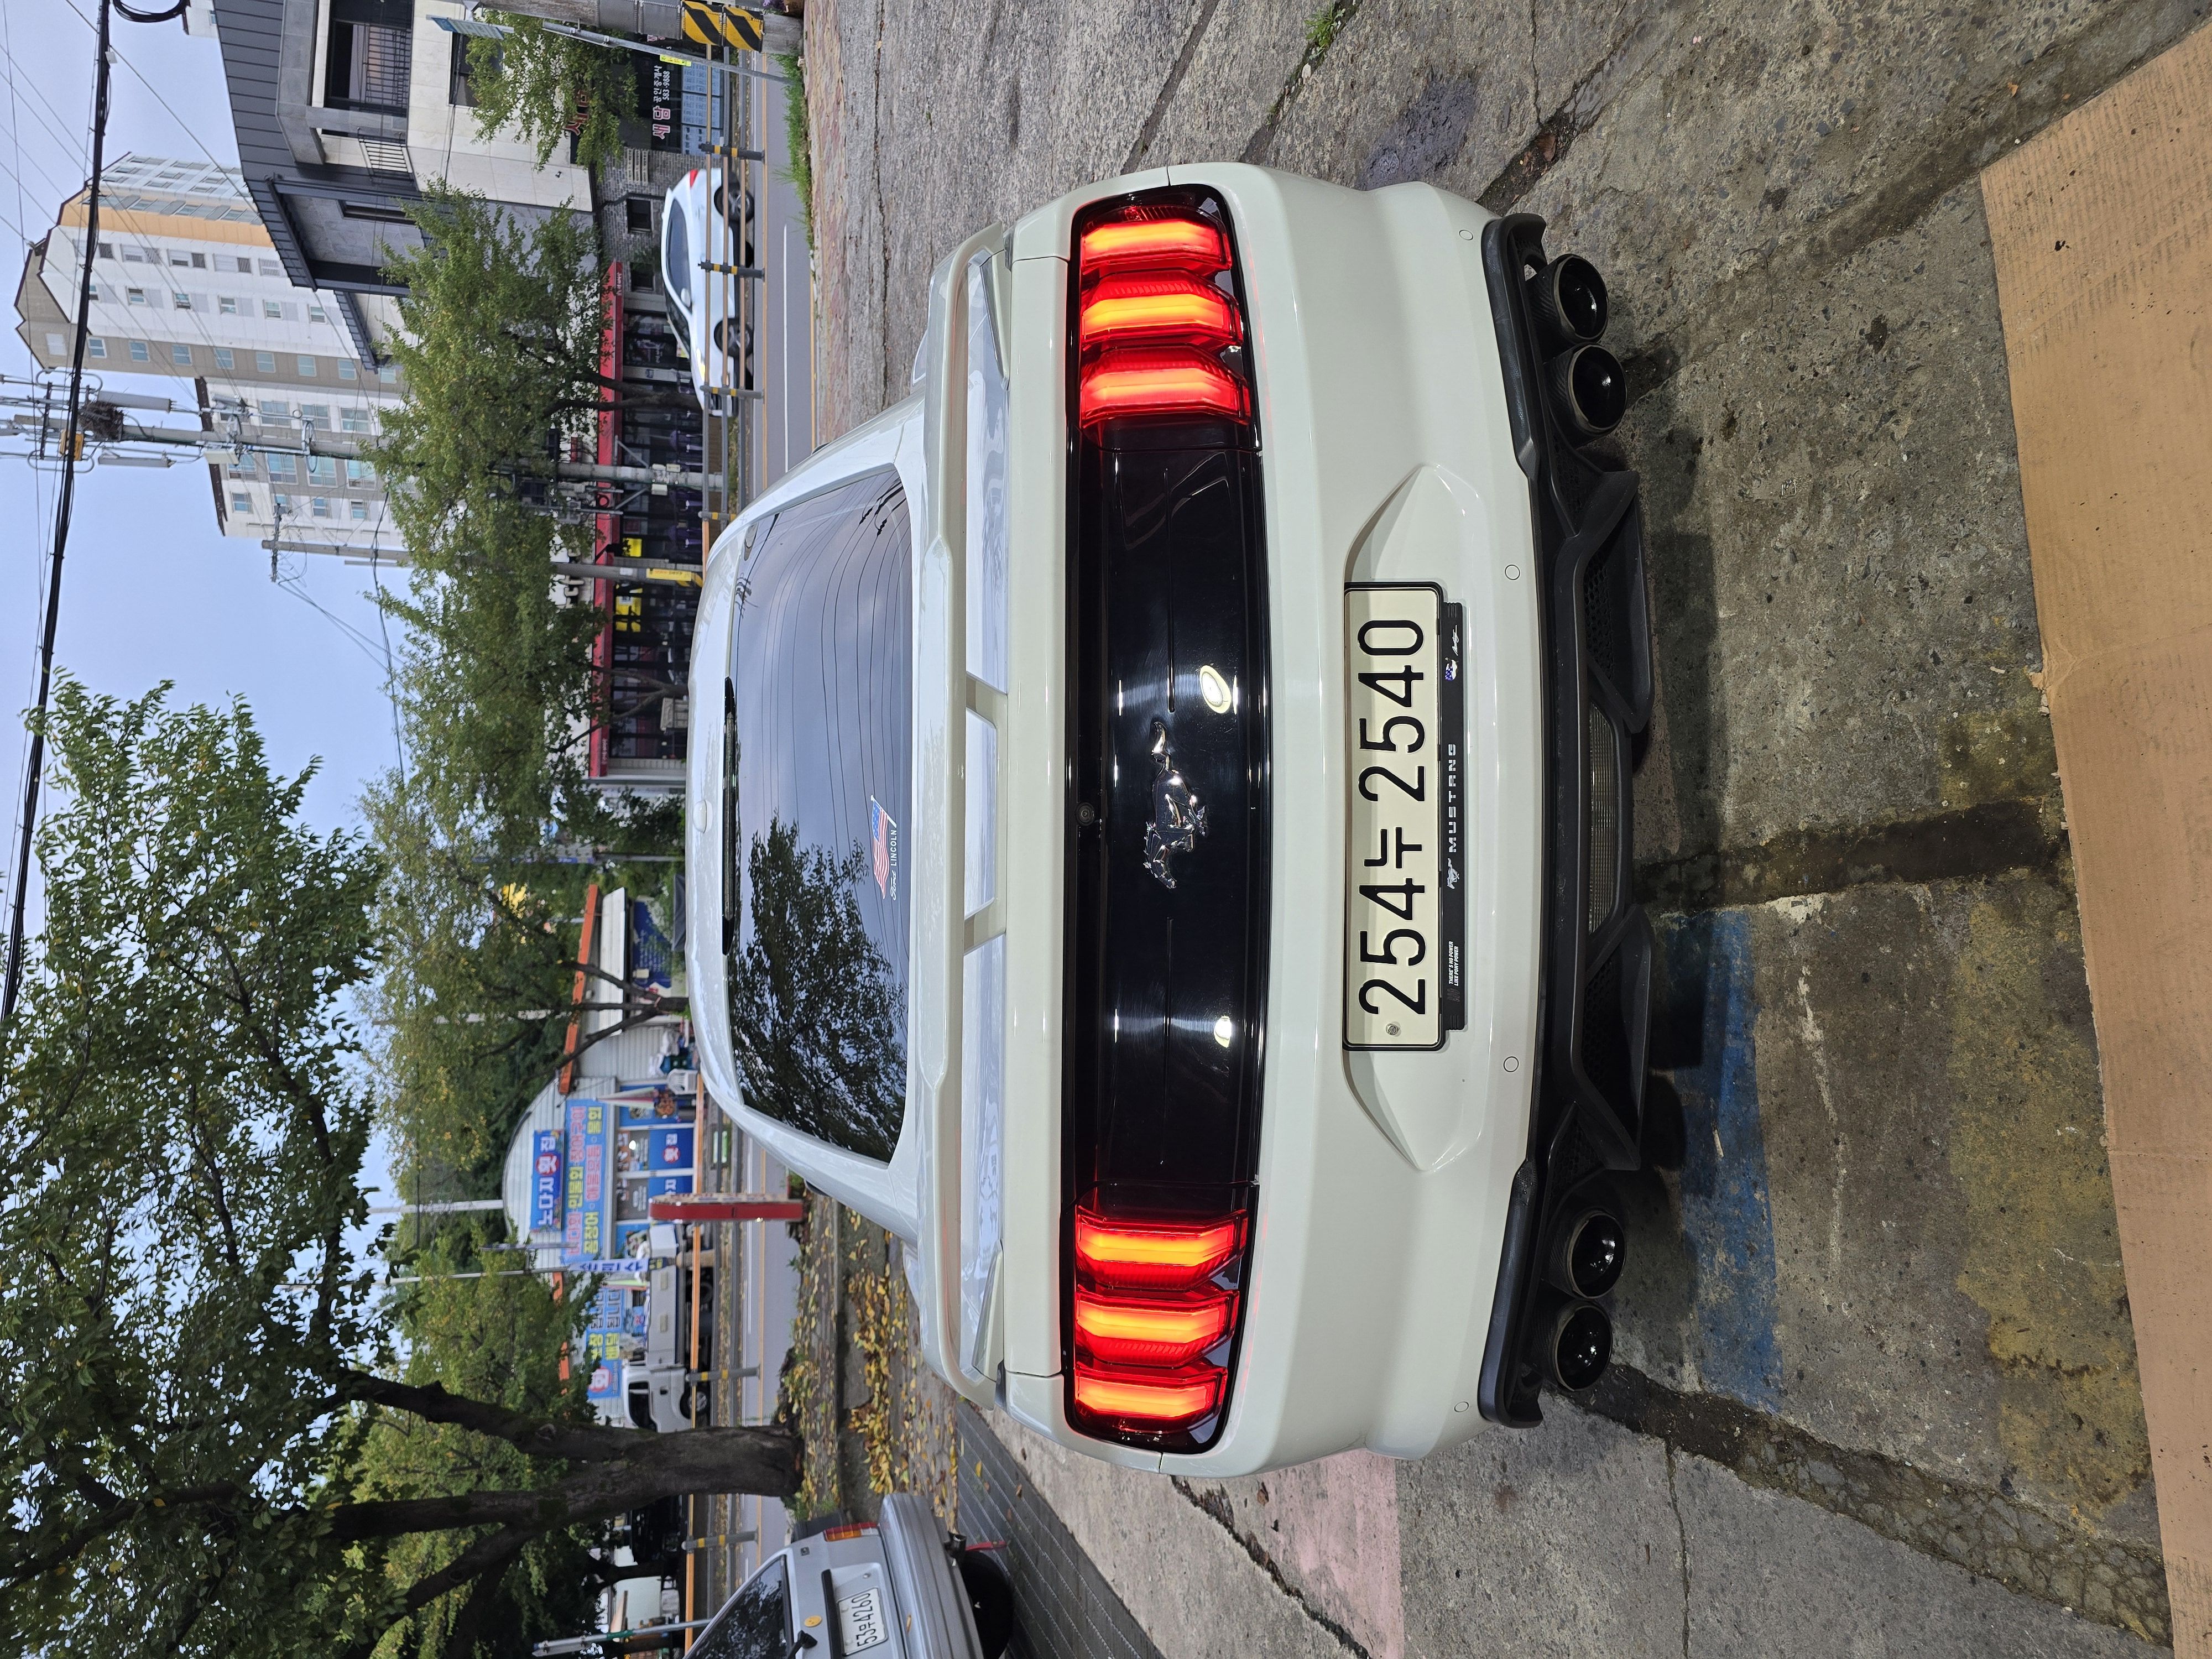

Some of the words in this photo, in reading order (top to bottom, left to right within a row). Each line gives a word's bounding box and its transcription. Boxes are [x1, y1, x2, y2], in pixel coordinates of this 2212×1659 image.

[653, 65, 662, 103] 공인중개사
[652, 106, 671, 139] 새담
[1357, 619, 1425, 802] 2540
[1448, 744, 1457, 853] MUSTANG
[1358, 826, 1426, 1015] 254누
[586, 1106, 602, 1134] 물회
[538, 1177, 554, 1225] 노다지
[583, 1211, 599, 1254] 꼼장어
[607, 1288, 622, 1328] 됩니다
[851, 1593, 877, 1647] 53무4260
